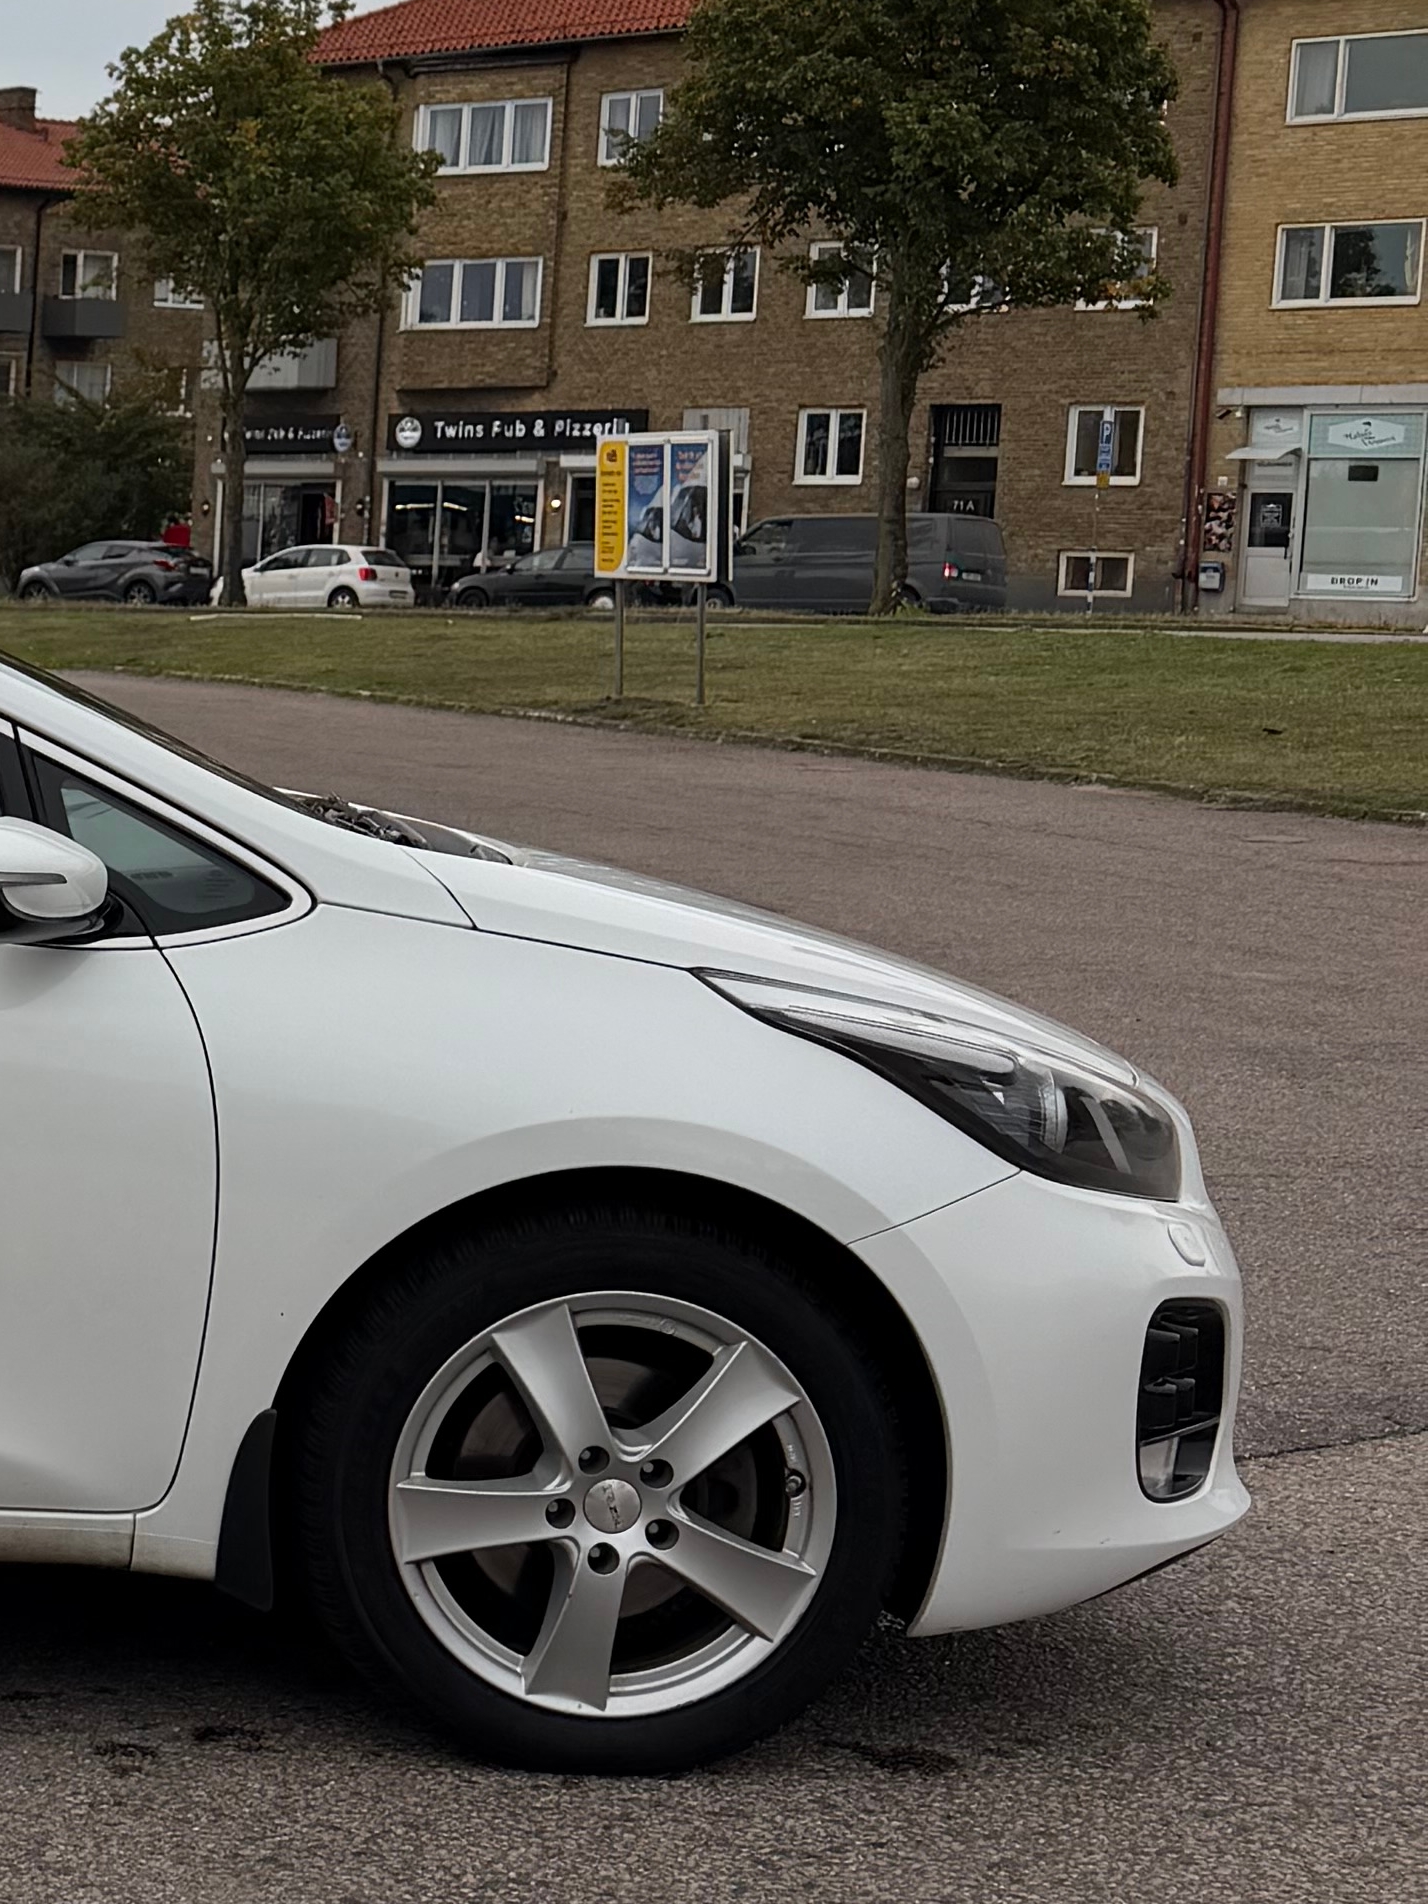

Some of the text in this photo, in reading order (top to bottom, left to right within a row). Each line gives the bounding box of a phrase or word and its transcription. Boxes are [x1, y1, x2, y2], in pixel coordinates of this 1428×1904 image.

[434, 420, 484, 439] Twins
[491, 420, 526, 438] Pub
[532, 418, 545, 437] &
[1103, 423, 1112, 442] P
[1330, 576, 1379, 586] DROP IN
